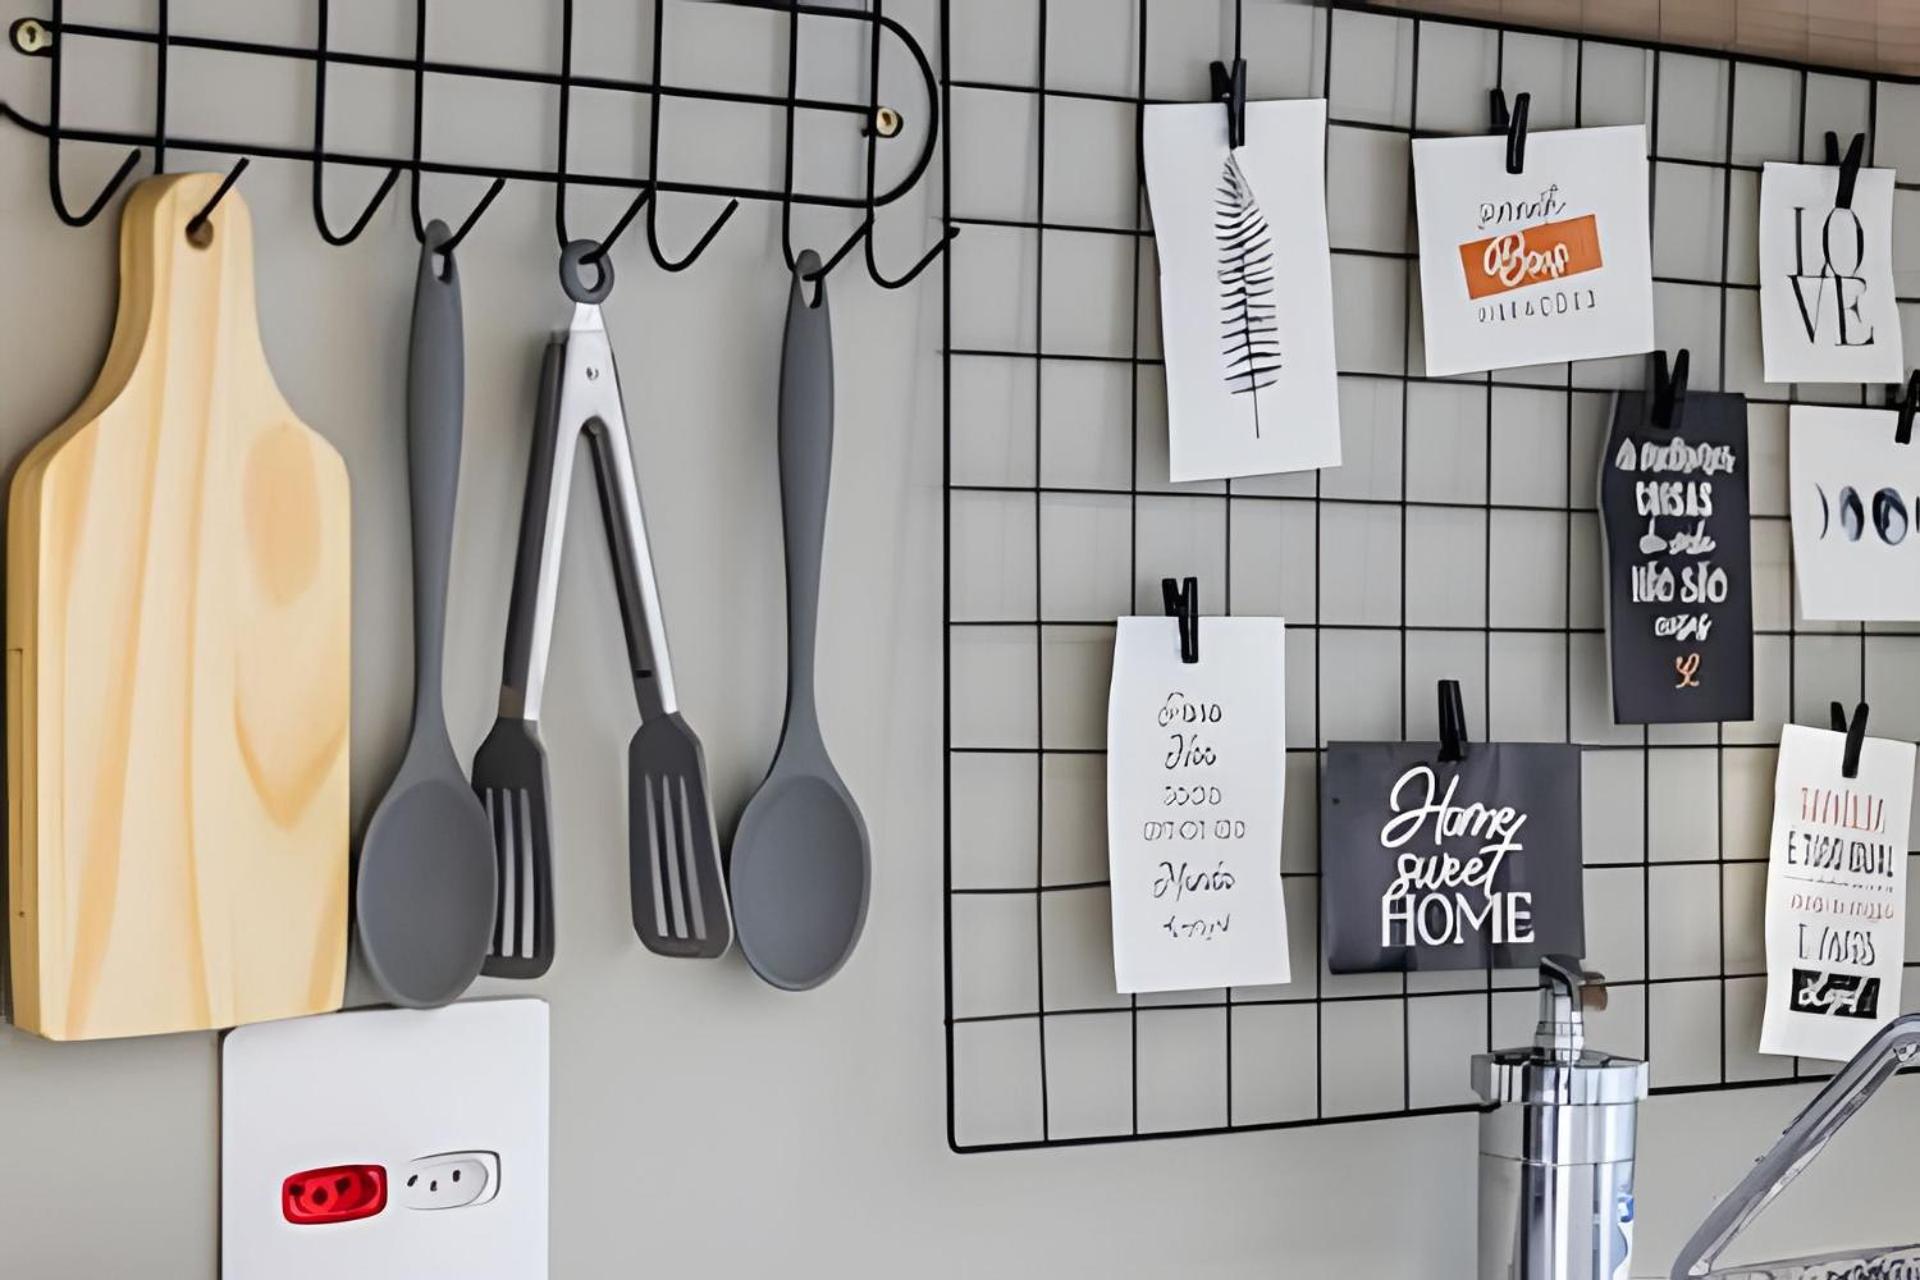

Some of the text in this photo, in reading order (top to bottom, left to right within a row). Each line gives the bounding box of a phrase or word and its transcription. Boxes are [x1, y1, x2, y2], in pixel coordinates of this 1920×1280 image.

[1380, 766, 1518, 848] Home
[1384, 814, 1527, 900] sweet
[1381, 892, 1535, 947] HOME
